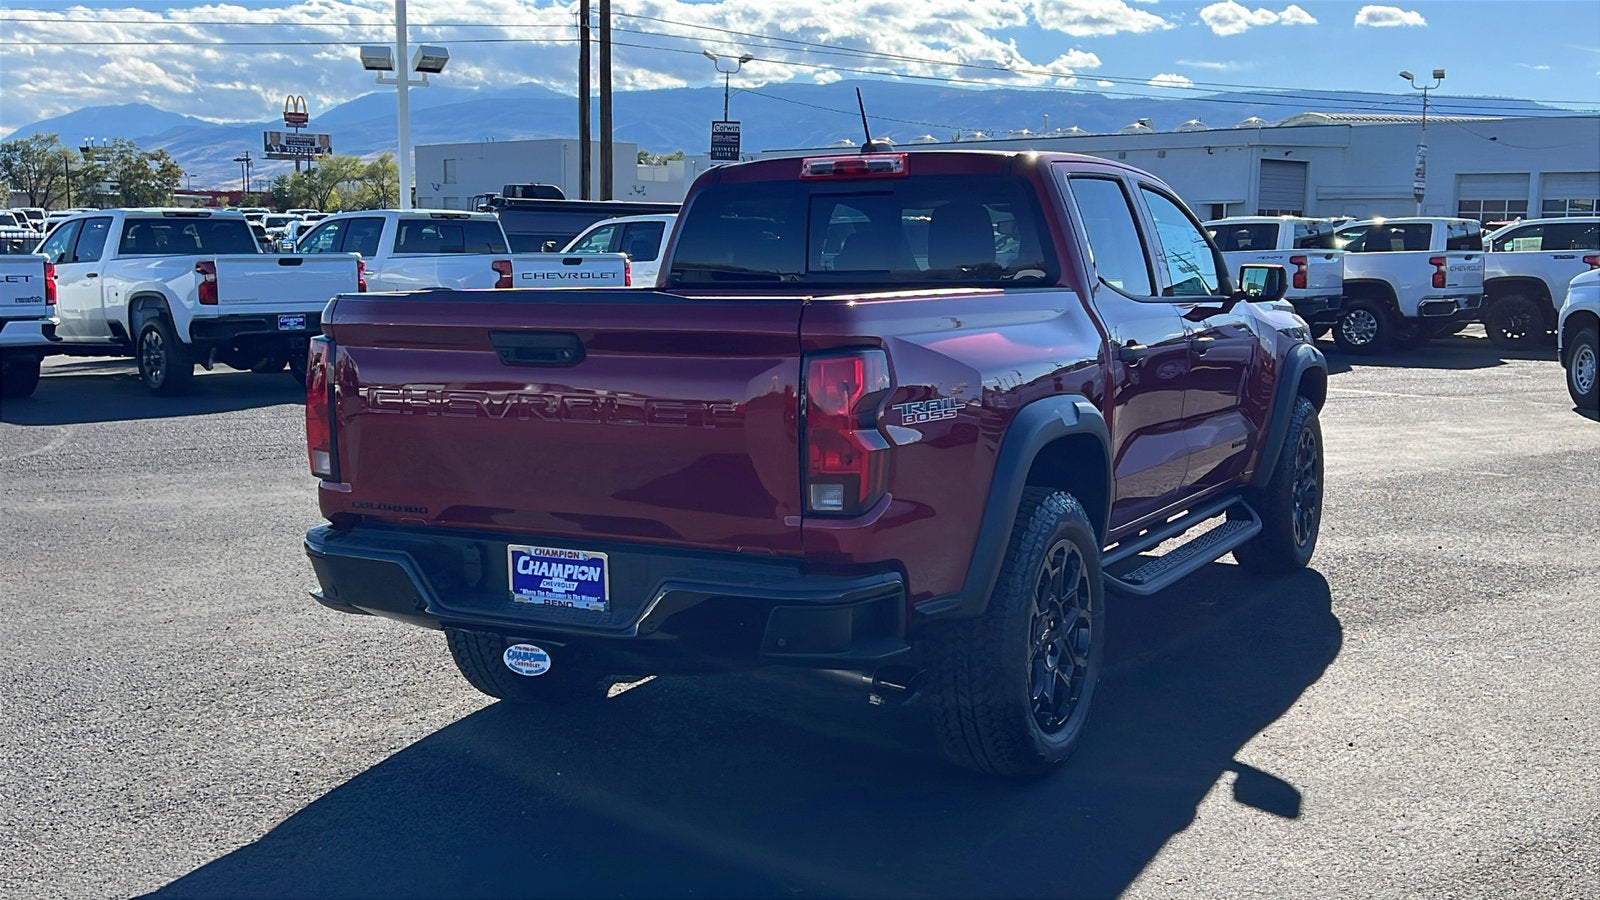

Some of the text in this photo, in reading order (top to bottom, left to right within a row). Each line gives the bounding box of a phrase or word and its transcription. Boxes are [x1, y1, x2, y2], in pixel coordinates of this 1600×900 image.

[714, 123, 740, 132] Corwin
[521, 271, 619, 280] CHEVROLET
[366, 386, 742, 429] CHEVROLET
[891, 397, 966, 415] TRAIL
[902, 409, 958, 426] BOSS
[534, 548, 580, 559] CHAMPION
[517, 555, 601, 582] CHAMPION
[542, 580, 576, 590] CHEVROLET
